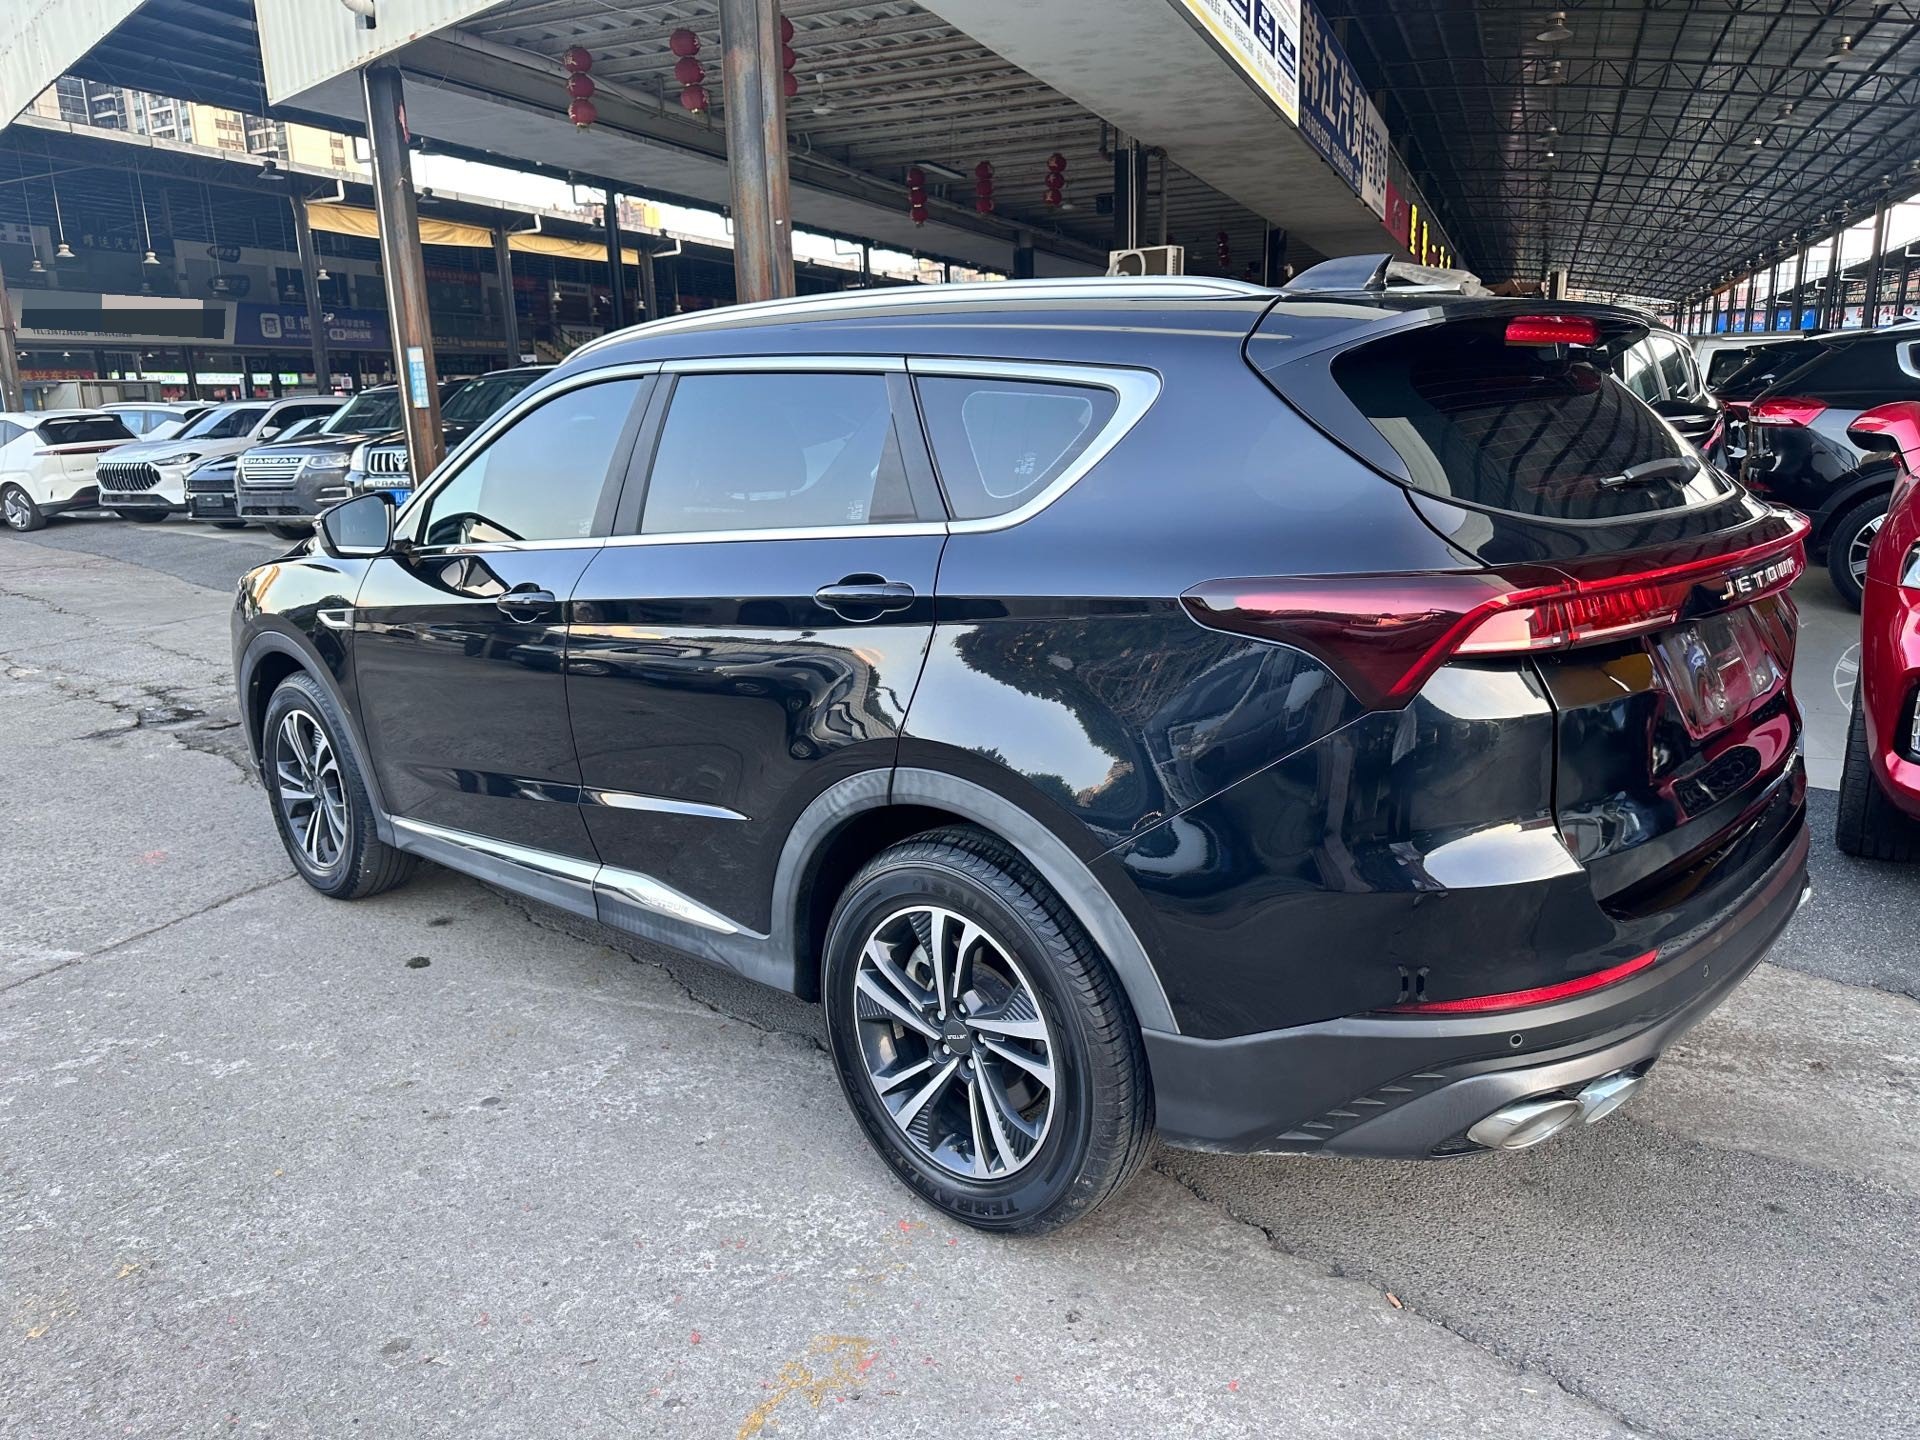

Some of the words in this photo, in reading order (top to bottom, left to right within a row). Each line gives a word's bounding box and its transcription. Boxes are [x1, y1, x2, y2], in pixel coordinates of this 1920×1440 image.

[1301, 1, 1364, 164] 韩江汽贸
[1722, 556, 1796, 600] JETOUR
